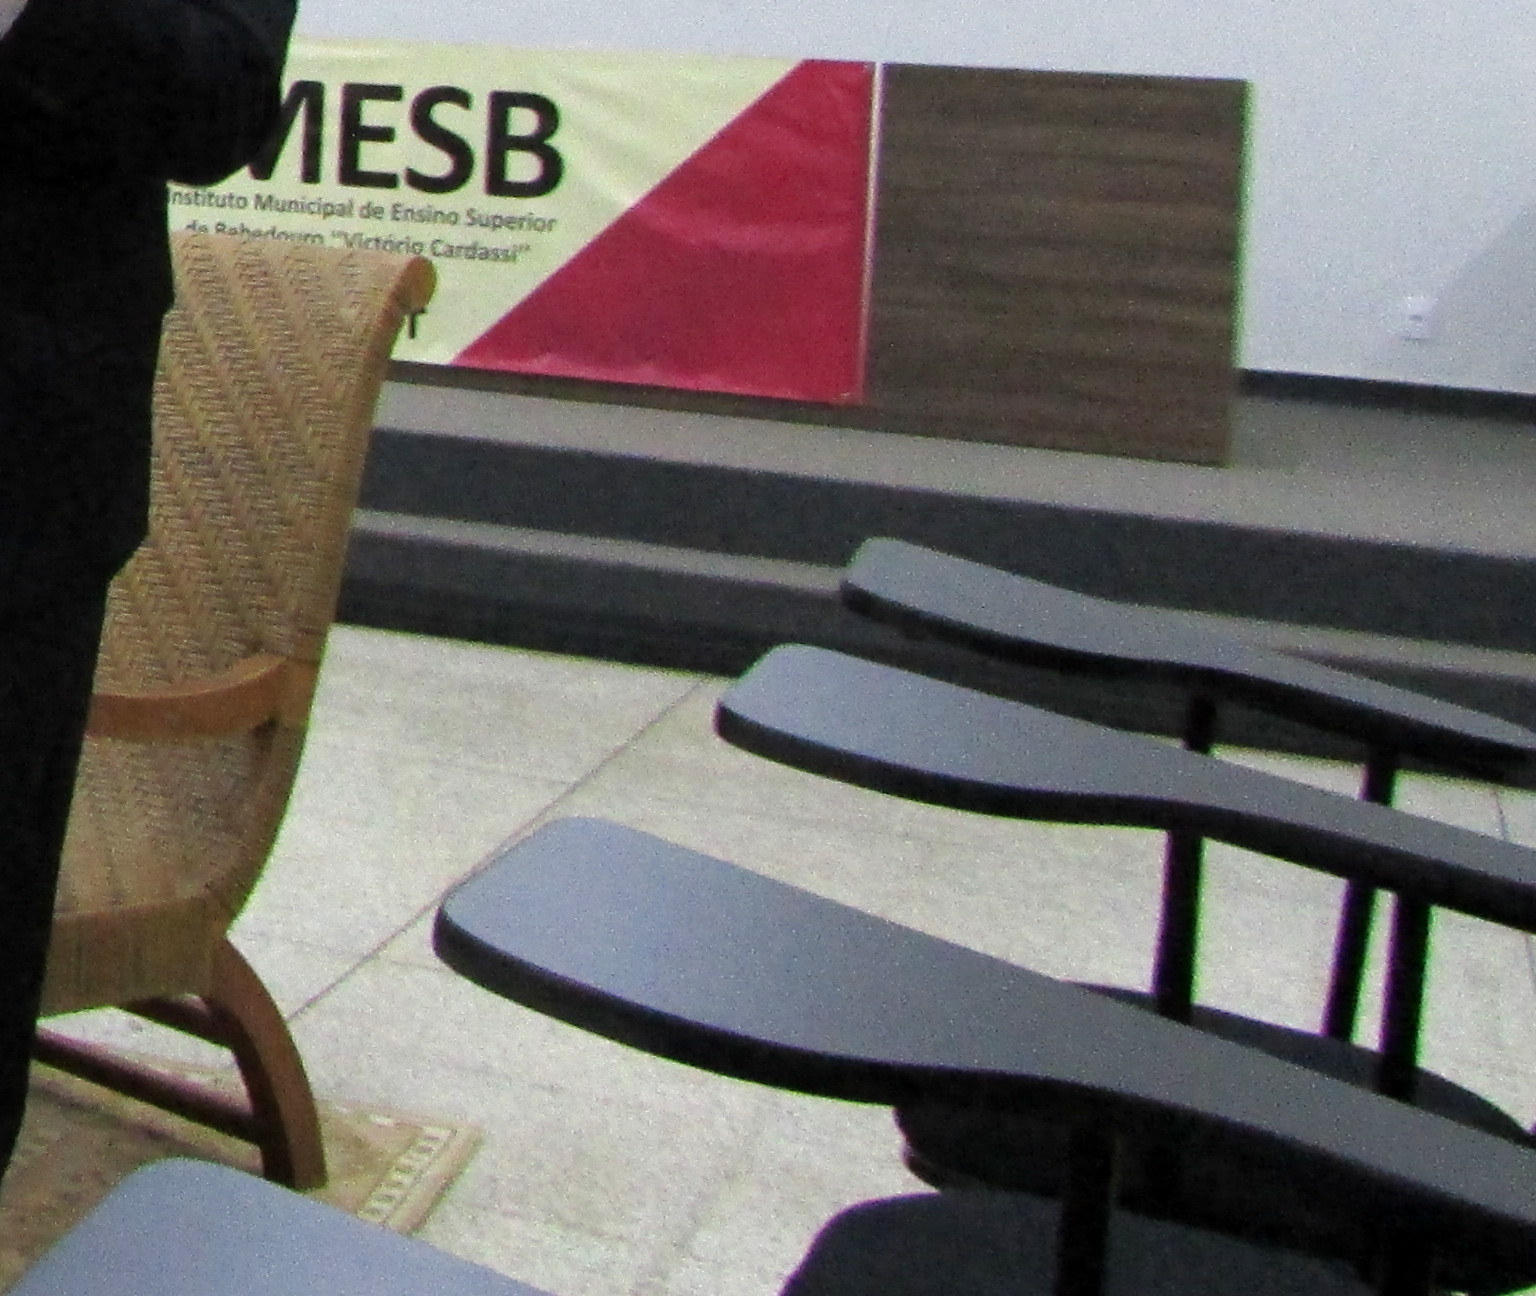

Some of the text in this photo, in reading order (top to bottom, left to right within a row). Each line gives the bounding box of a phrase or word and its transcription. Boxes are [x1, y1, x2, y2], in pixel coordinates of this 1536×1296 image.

[247, 79, 565, 198] MESB
[171, 190, 557, 233] nstituto Municipal de Ensino Superior
